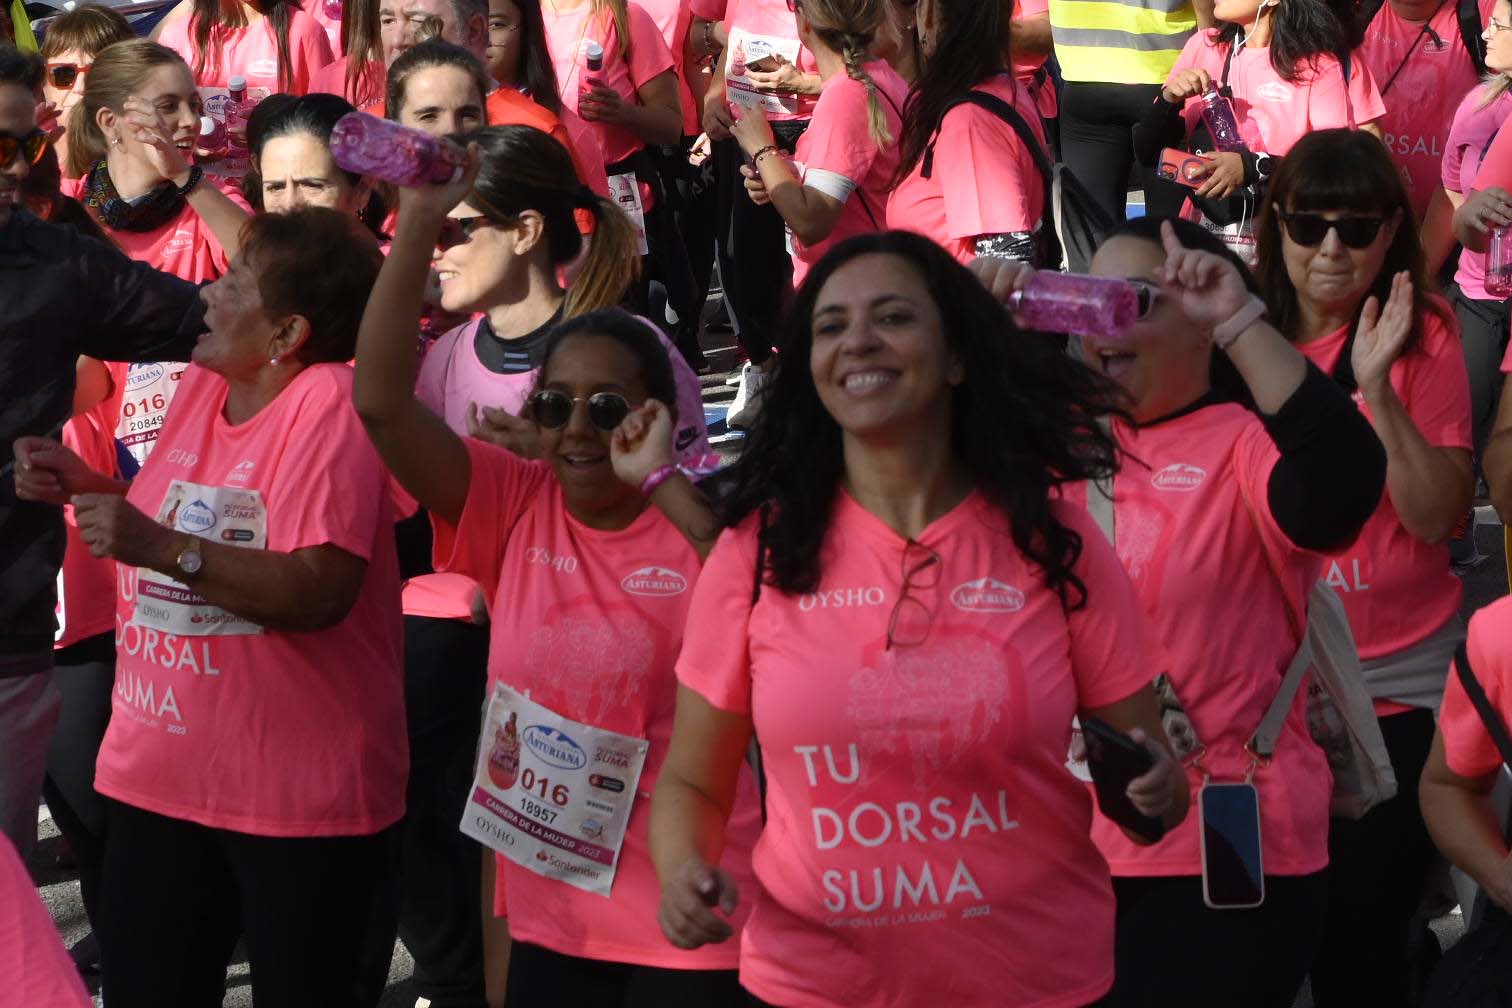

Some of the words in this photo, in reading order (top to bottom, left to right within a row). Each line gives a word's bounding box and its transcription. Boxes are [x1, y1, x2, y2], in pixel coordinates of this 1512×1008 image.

[127, 370, 160, 385] TURIANA
[123, 394, 165, 417] 016
[130, 415, 164, 431] 20849
[799, 587, 885, 611] OYSHO
[529, 731, 580, 766] ASTURIANA
[794, 744, 860, 787] TU
[521, 768, 570, 806] 016
[486, 798, 519, 825] CARRERA
[519, 818, 530, 829] DE
[531, 824, 543, 835] LA
[543, 831, 575, 849] MUJER
[521, 798, 557, 824] 18957
[812, 790, 1019, 850] DORSAL
[476, 816, 515, 846] OYSHO
[550, 855, 600, 880] Santander
[823, 859, 984, 913] SUMA
